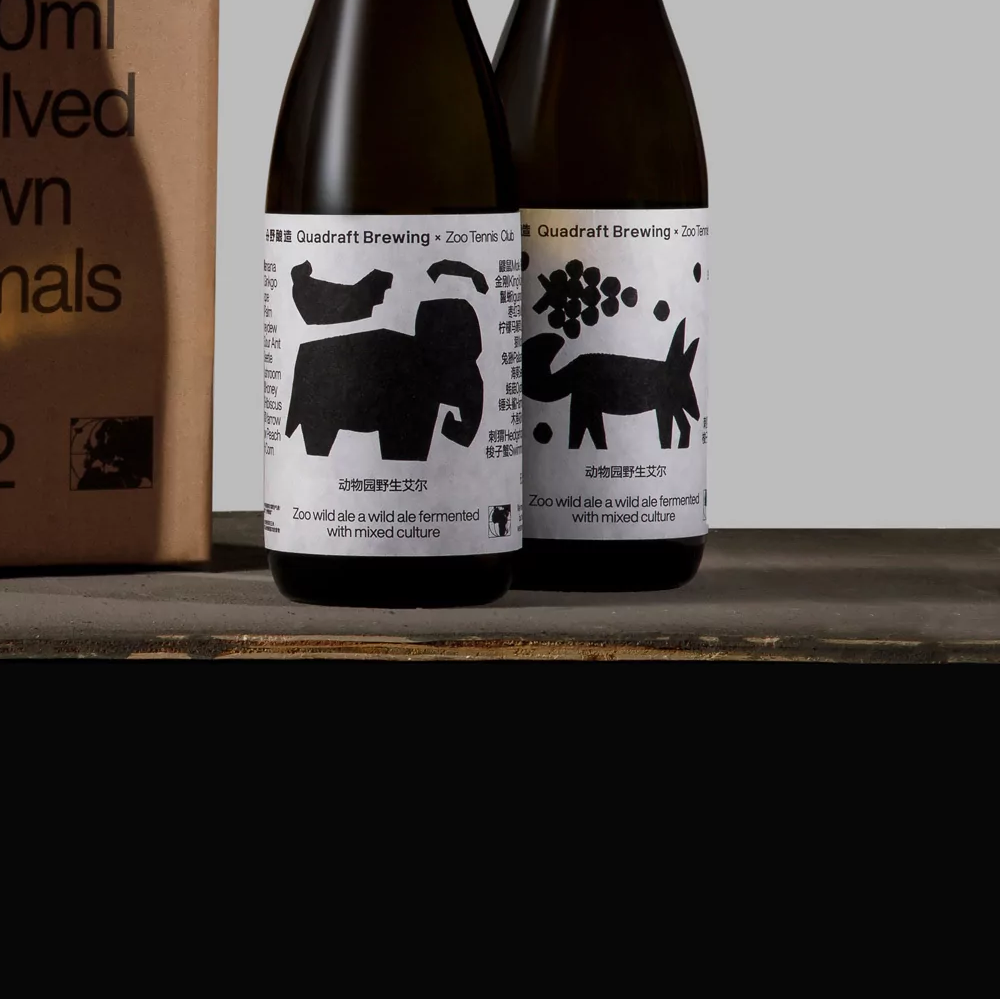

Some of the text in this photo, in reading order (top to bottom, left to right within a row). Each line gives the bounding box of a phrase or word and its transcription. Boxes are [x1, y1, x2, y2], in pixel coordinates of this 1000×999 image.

[297, 230, 359, 243] Quadraft
[364, 231, 430, 246] Brewing
[446, 231, 468, 243] Zoo
[469, 231, 498, 242] Tennis
[538, 225, 609, 237] Quadraft
[613, 225, 670, 240] Brewing
[682, 225, 696, 237] Zoo
[585, 465, 666, 478] 动物园野生艾尔
[339, 478, 427, 492] 动物园野生艾尔
[529, 493, 699, 508] Zoo wild ale a wild ale fermented
[293, 507, 311, 520] Zoo
[313, 509, 335, 521] wild
[338, 510, 355, 522] ale
[358, 513, 366, 522] a
[368, 510, 394, 522] wild
[397, 510, 416, 522] ale
[418, 509, 479, 522] fermented
[572, 510, 675, 523] with mixed culture
[327, 525, 440, 538] with mixed culture
